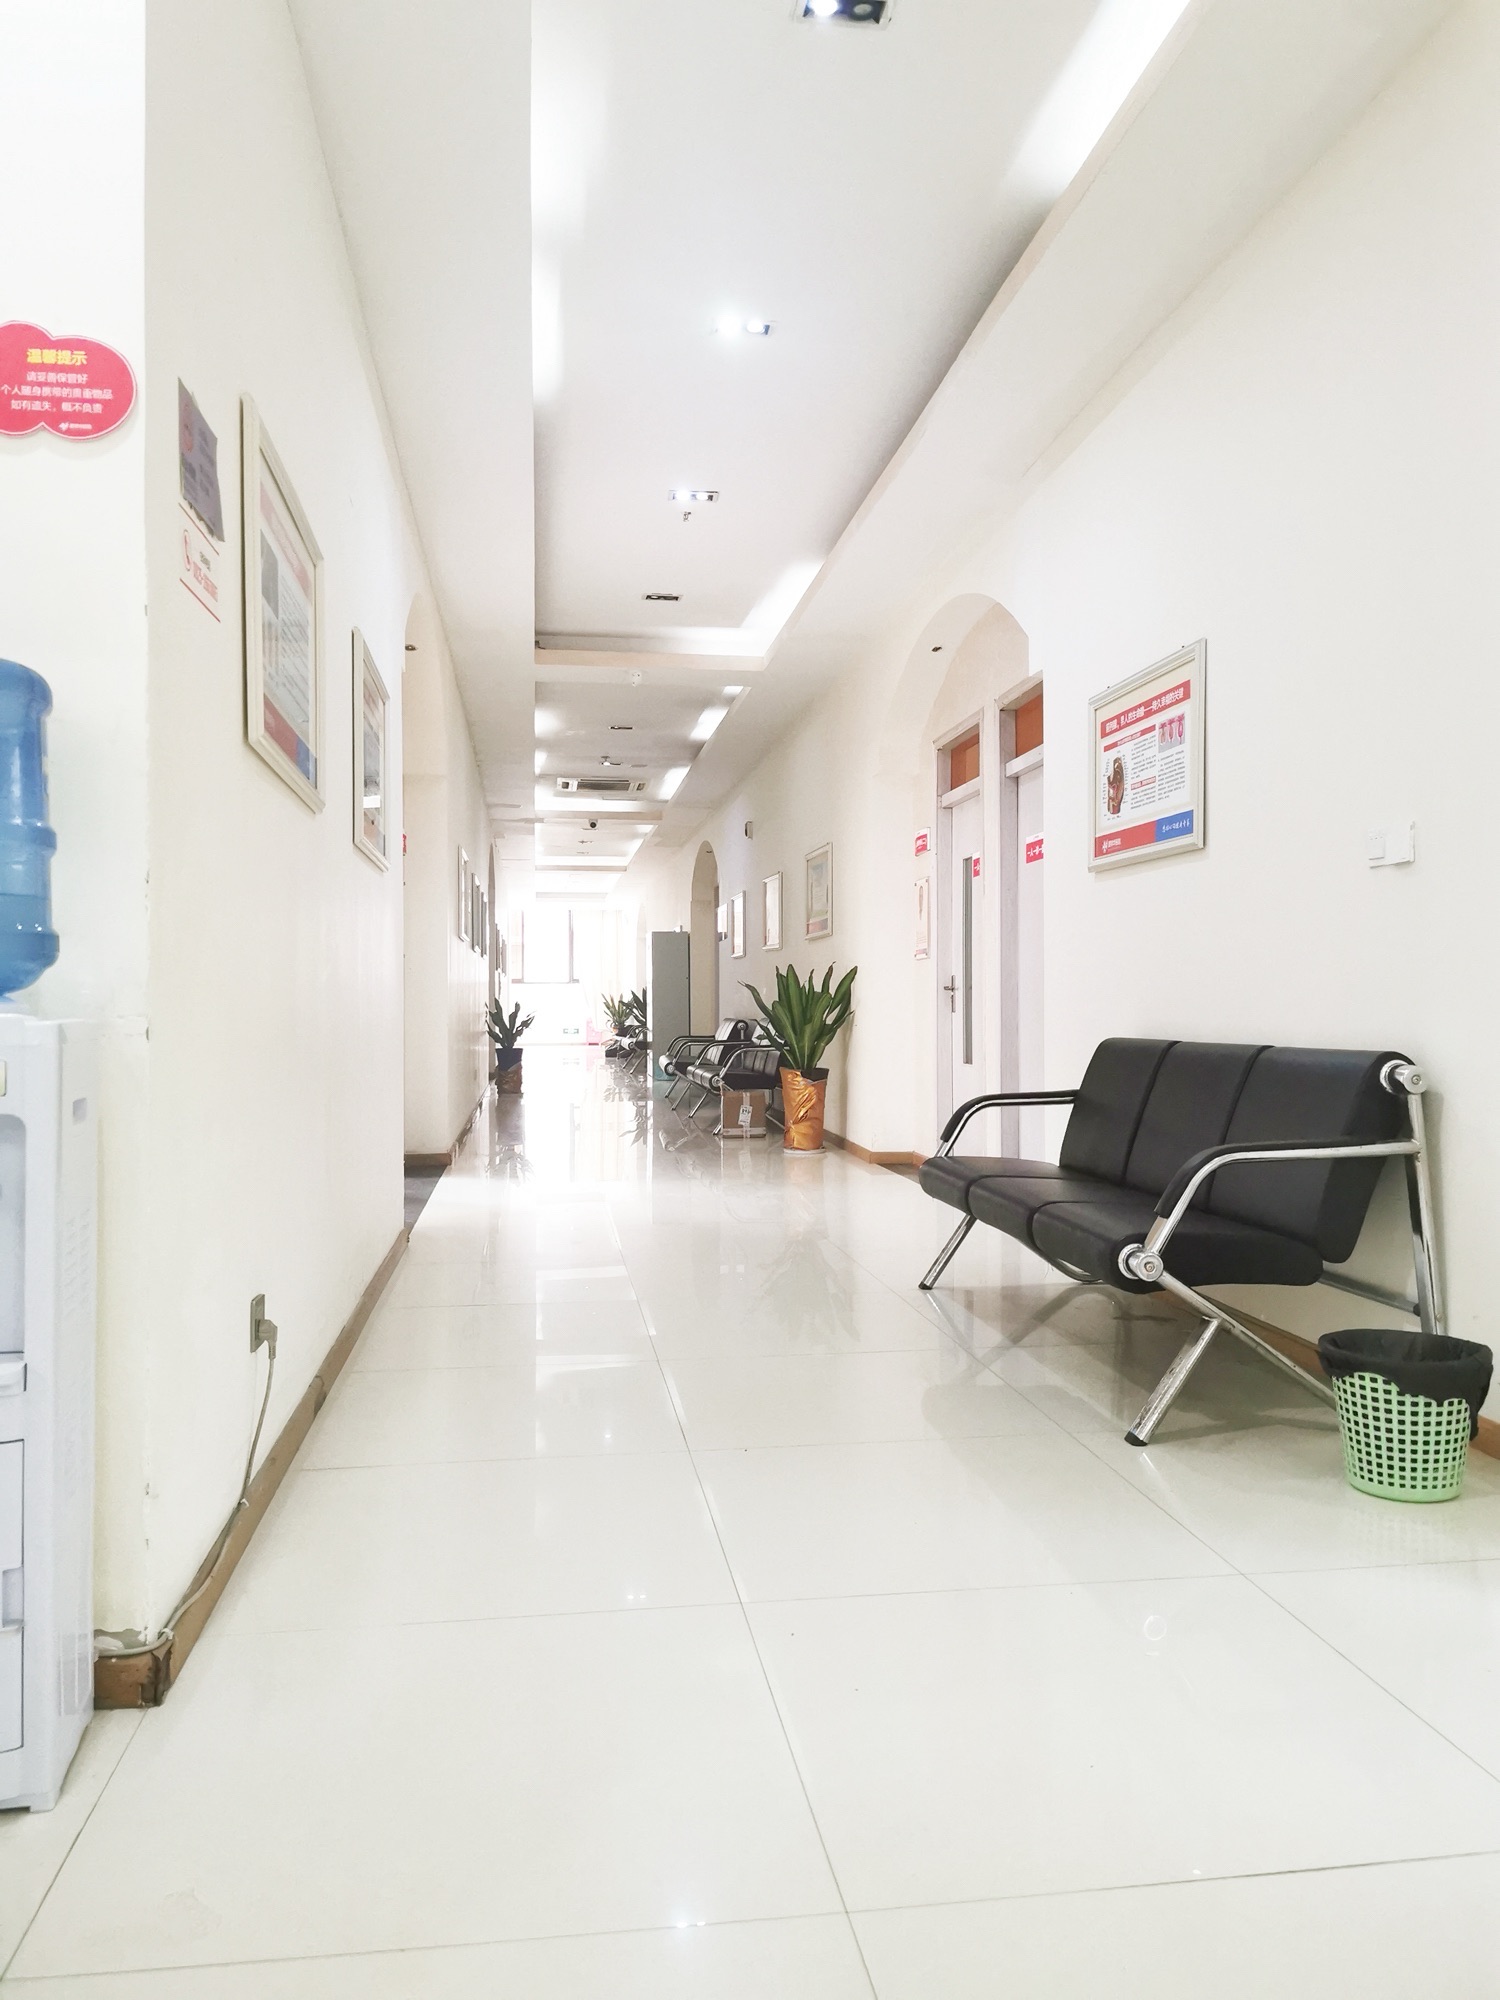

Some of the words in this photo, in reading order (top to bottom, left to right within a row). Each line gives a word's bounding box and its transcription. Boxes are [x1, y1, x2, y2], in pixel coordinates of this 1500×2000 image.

[26, 348, 88, 366] 温馨提示
[26, 371, 88, 384] 请妥善保管好
[0, 384, 113, 399] 个人随身携带的贵重物品
